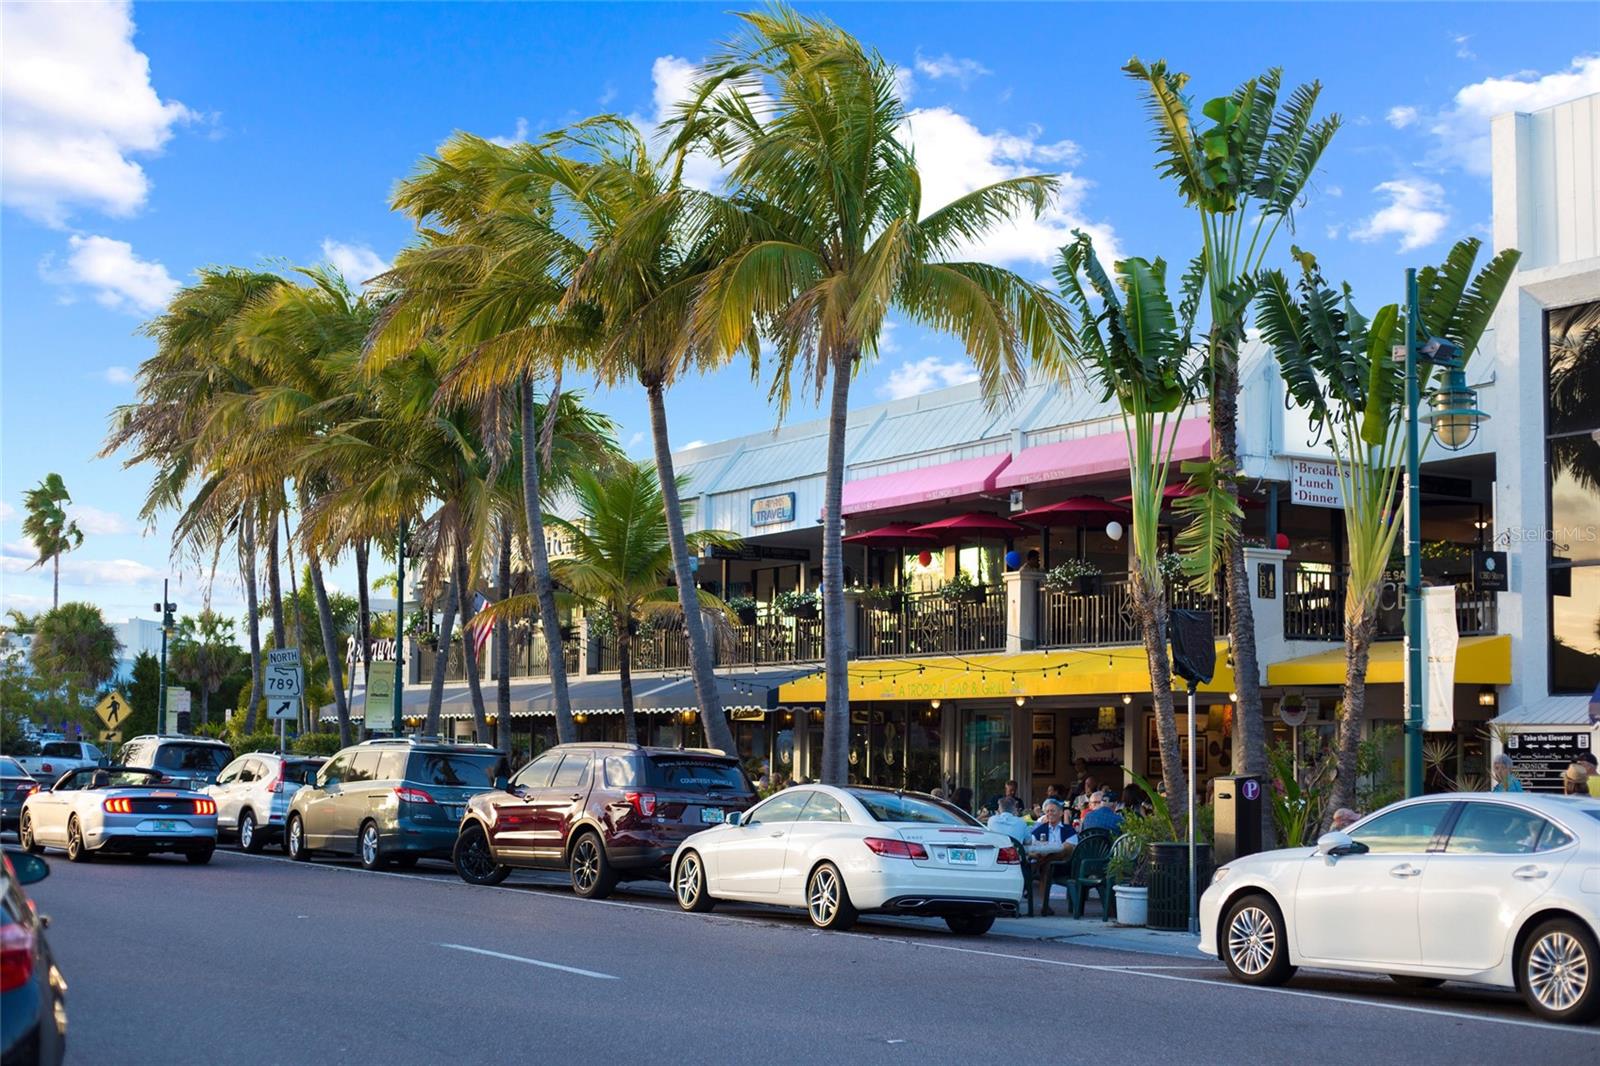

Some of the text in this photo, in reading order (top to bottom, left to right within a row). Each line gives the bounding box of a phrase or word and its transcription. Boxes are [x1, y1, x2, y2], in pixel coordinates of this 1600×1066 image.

[1299, 477, 1333, 490] Lunch
[1299, 491, 1338, 504] Dinner
[757, 508, 786, 521] TRAVEL
[270, 652, 297, 663] NORTH
[269, 678, 294, 690] 789
[1548, 735, 1573, 743] Elevator
[1247, 783, 1257, 798] P
